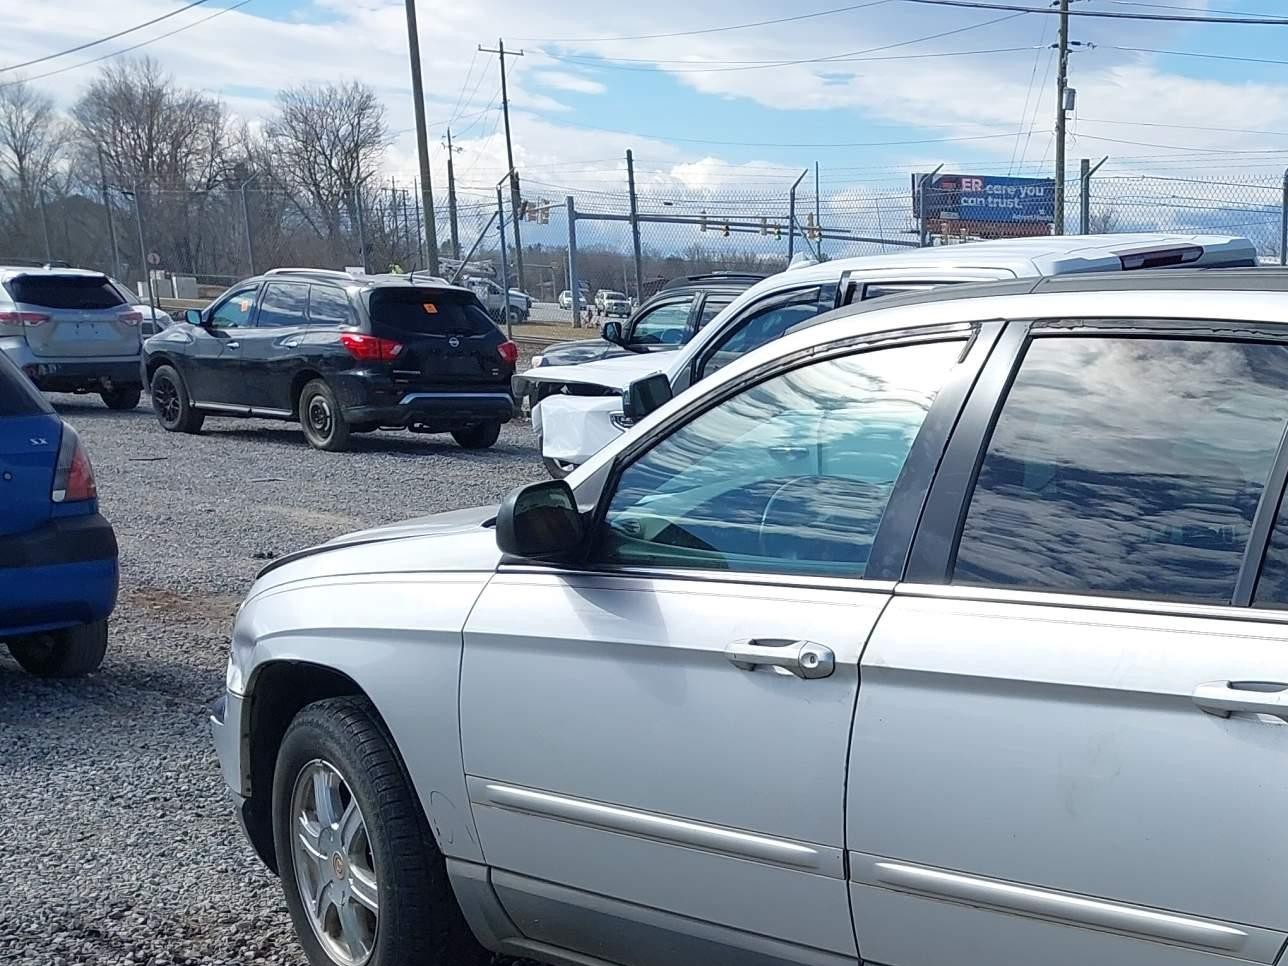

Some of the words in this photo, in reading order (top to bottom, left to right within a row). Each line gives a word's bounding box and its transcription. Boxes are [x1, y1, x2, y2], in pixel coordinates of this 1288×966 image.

[961, 178, 983, 192] ER
[985, 184, 1016, 195] care
[1019, 186, 1044, 198] you
[960, 196, 985, 206] can
